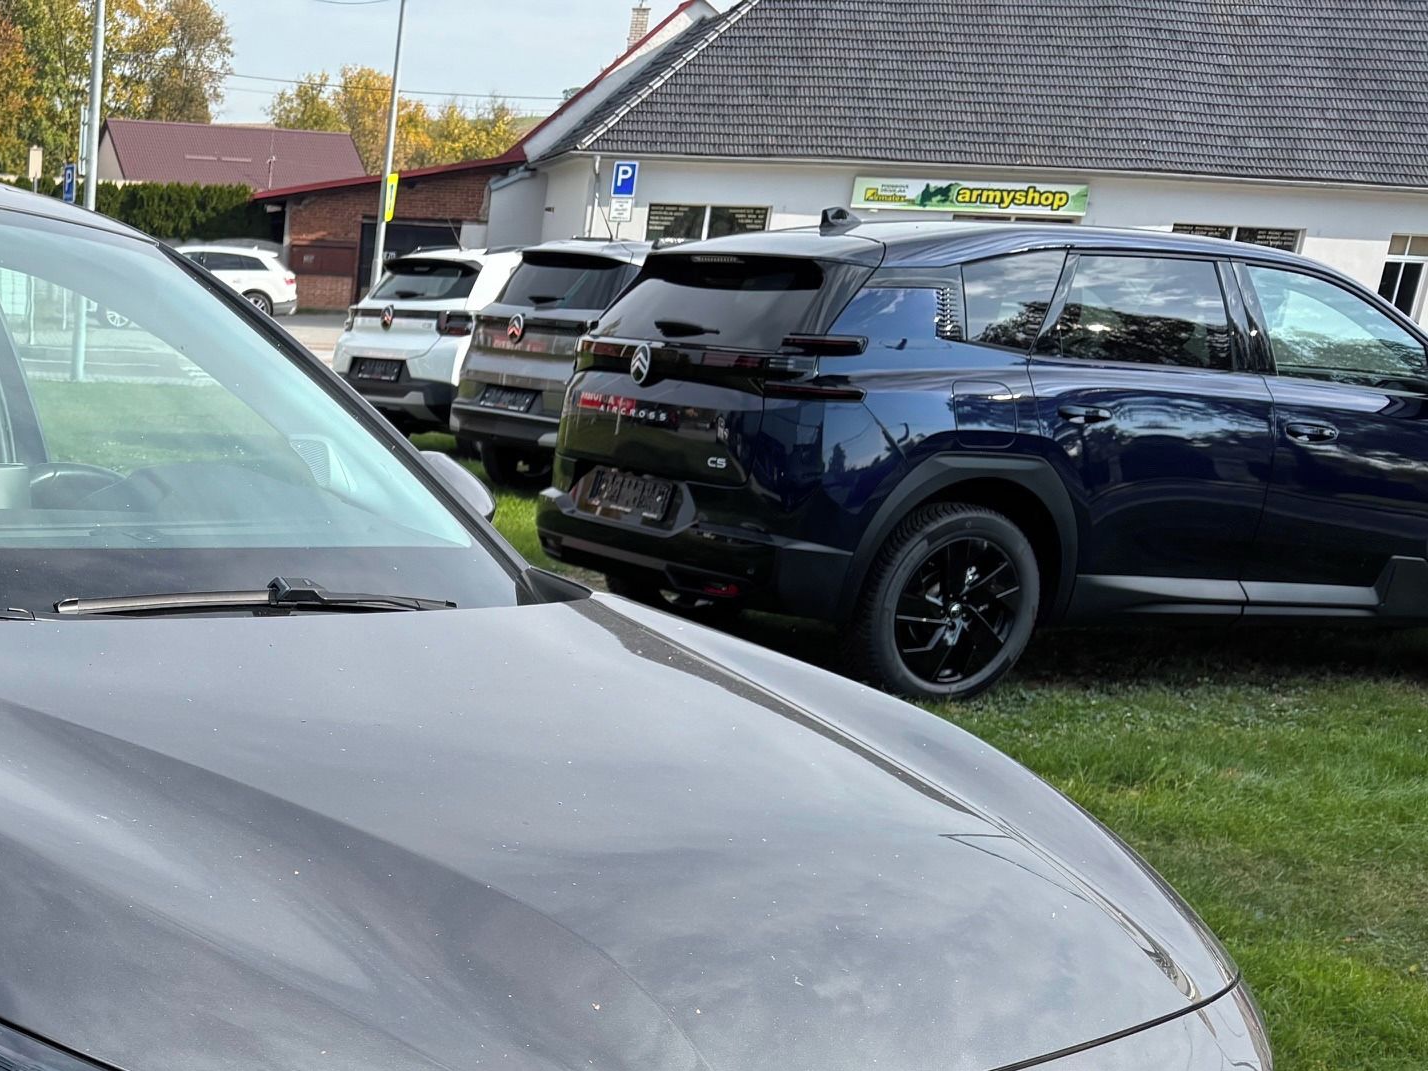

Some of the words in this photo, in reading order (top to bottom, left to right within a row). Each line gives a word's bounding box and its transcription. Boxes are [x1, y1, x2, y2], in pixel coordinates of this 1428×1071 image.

[65, 169, 73, 193] P
[617, 165, 633, 187] P
[955, 186, 1070, 211] armyshop
[599, 404, 667, 421] AIRCROSS
